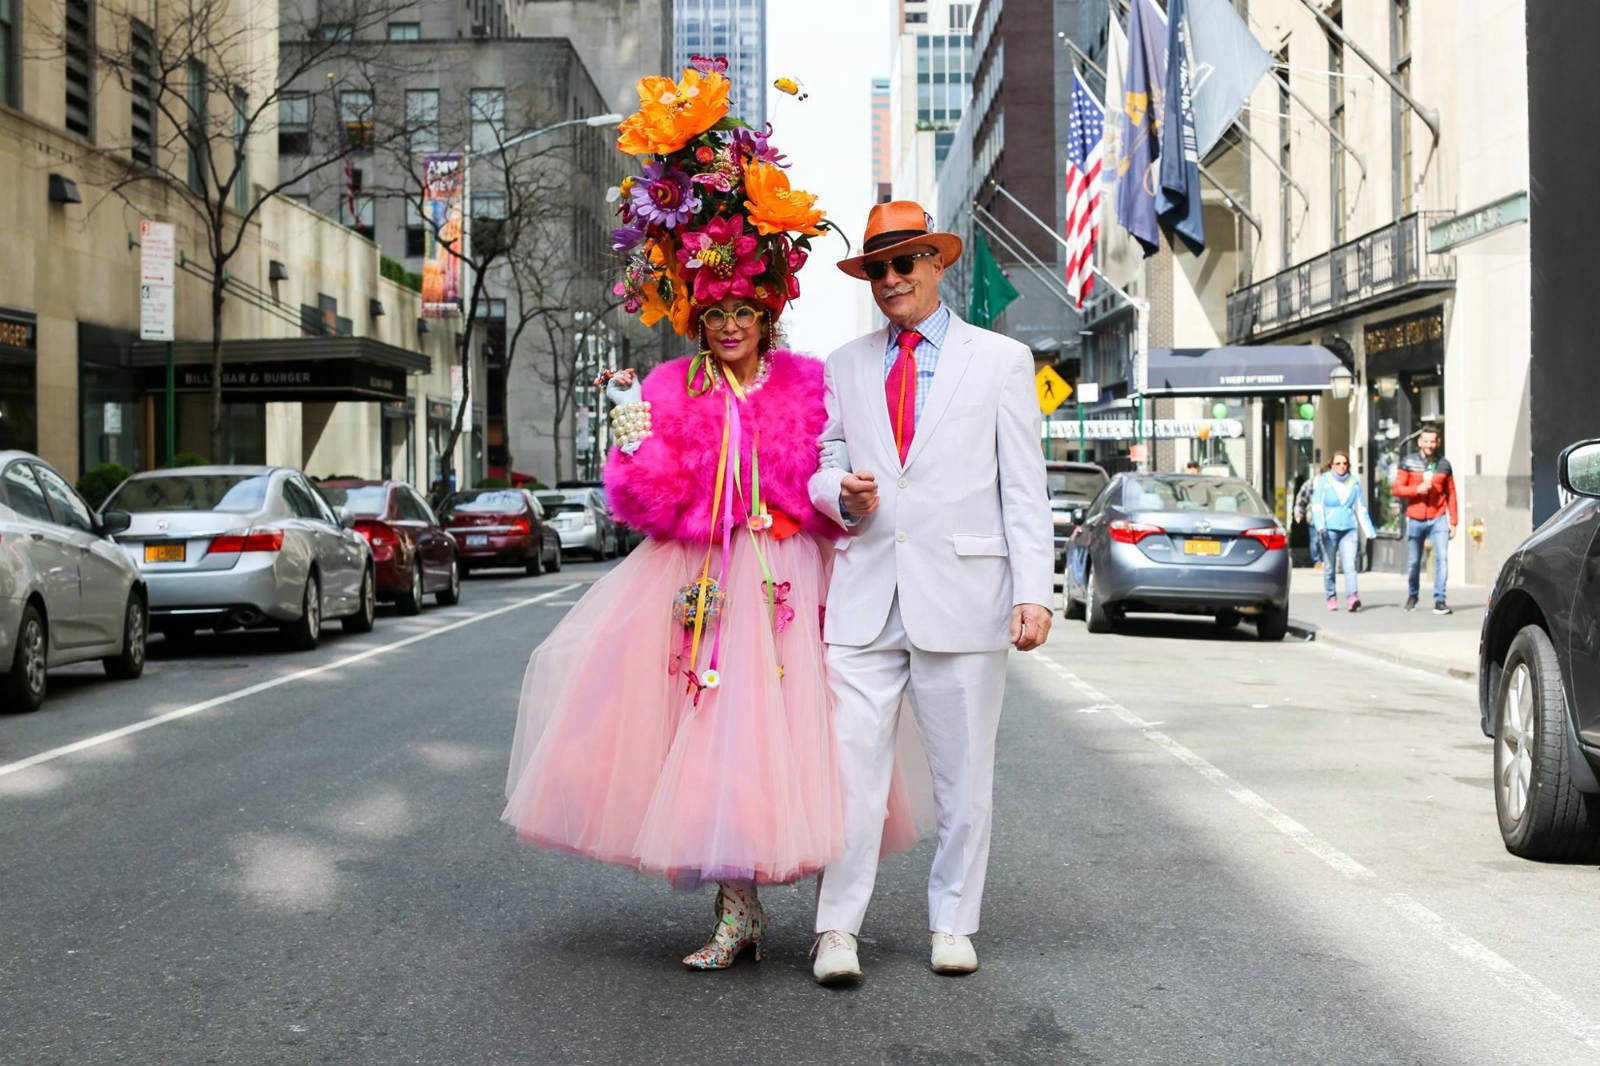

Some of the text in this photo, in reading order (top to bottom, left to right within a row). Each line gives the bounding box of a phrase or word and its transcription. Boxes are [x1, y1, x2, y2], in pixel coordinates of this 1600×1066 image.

[222, 372, 246, 384] BAR
[249, 372, 259, 384] &
[263, 372, 312, 384] BURGER
